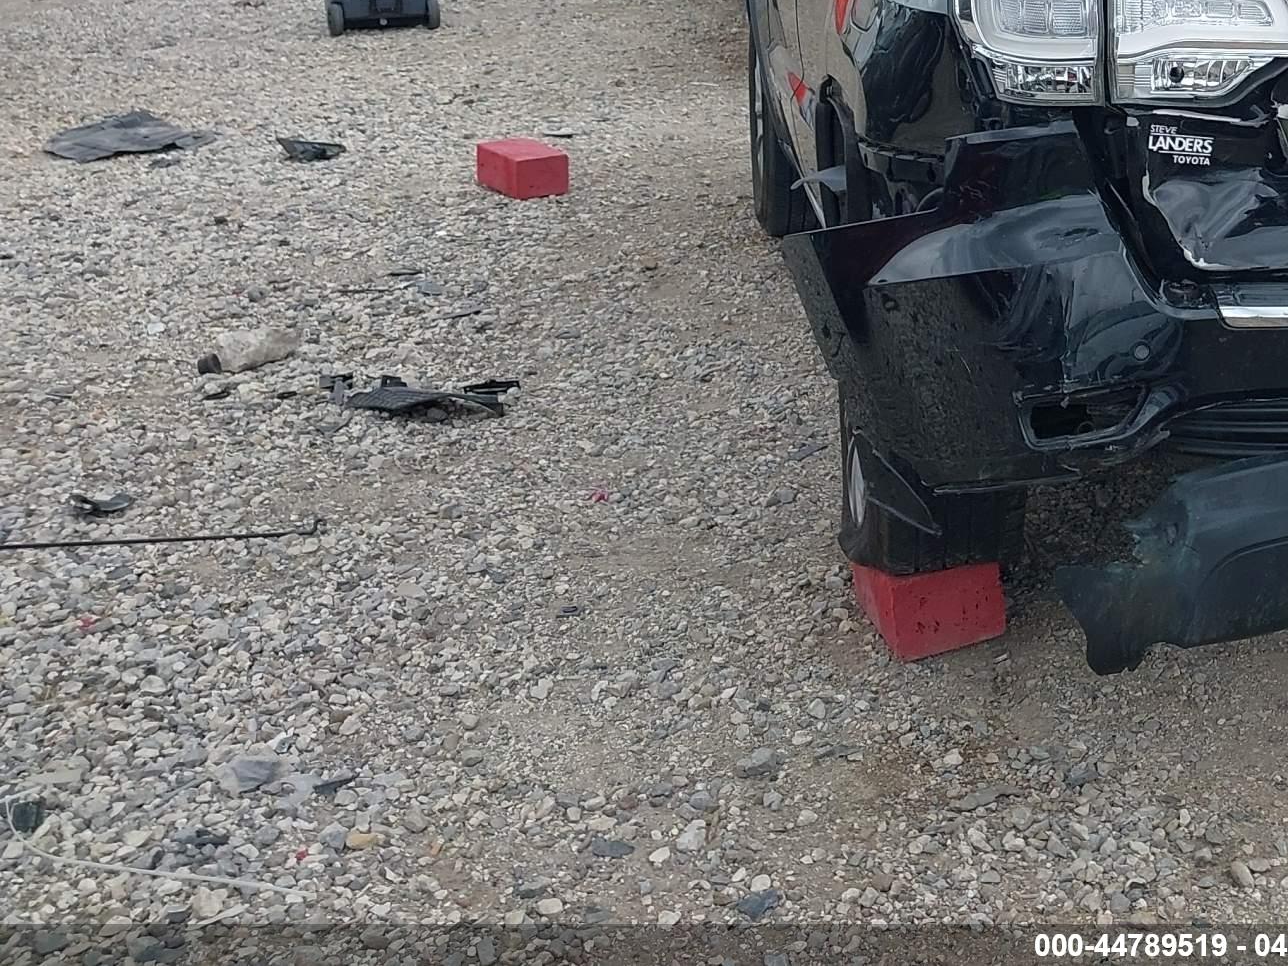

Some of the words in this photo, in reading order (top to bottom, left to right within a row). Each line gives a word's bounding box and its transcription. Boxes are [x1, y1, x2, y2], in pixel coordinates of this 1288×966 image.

[1150, 124, 1177, 133] STEVE
[1148, 135, 1213, 153] LANDERS
[1172, 155, 1211, 165] TOYOTA
